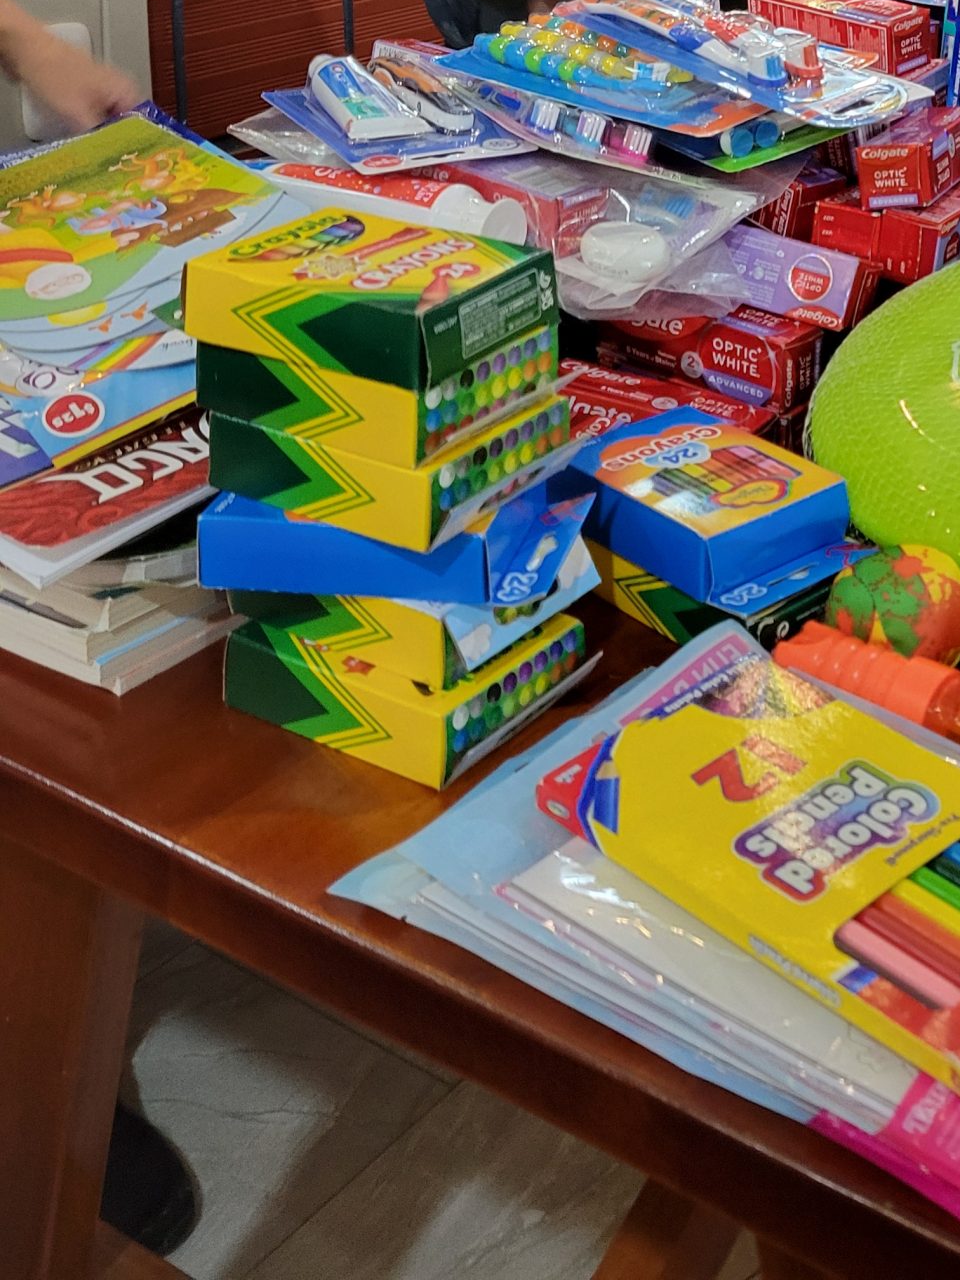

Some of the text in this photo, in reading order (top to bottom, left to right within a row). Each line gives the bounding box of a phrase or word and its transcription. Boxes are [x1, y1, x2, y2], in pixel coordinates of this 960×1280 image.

[894, 16, 924, 32] Colgate
[900, 33, 922, 48] OPTIC
[861, 148, 909, 161] Colgate
[874, 167, 907, 179] OPTIC
[229, 214, 343, 257] Crayola
[350, 237, 476, 290] CRAYONS
[712, 337, 762, 363] OPTIC
[561, 360, 641, 386] Colgate
[783, 359, 793, 408] Colgate
[708, 375, 764, 399] ADVANCED
[602, 427, 722, 472] Crayons
[656, 445, 700, 466] 24
[742, 762, 895, 865] Pencils
[780, 770, 935, 895] Colored
